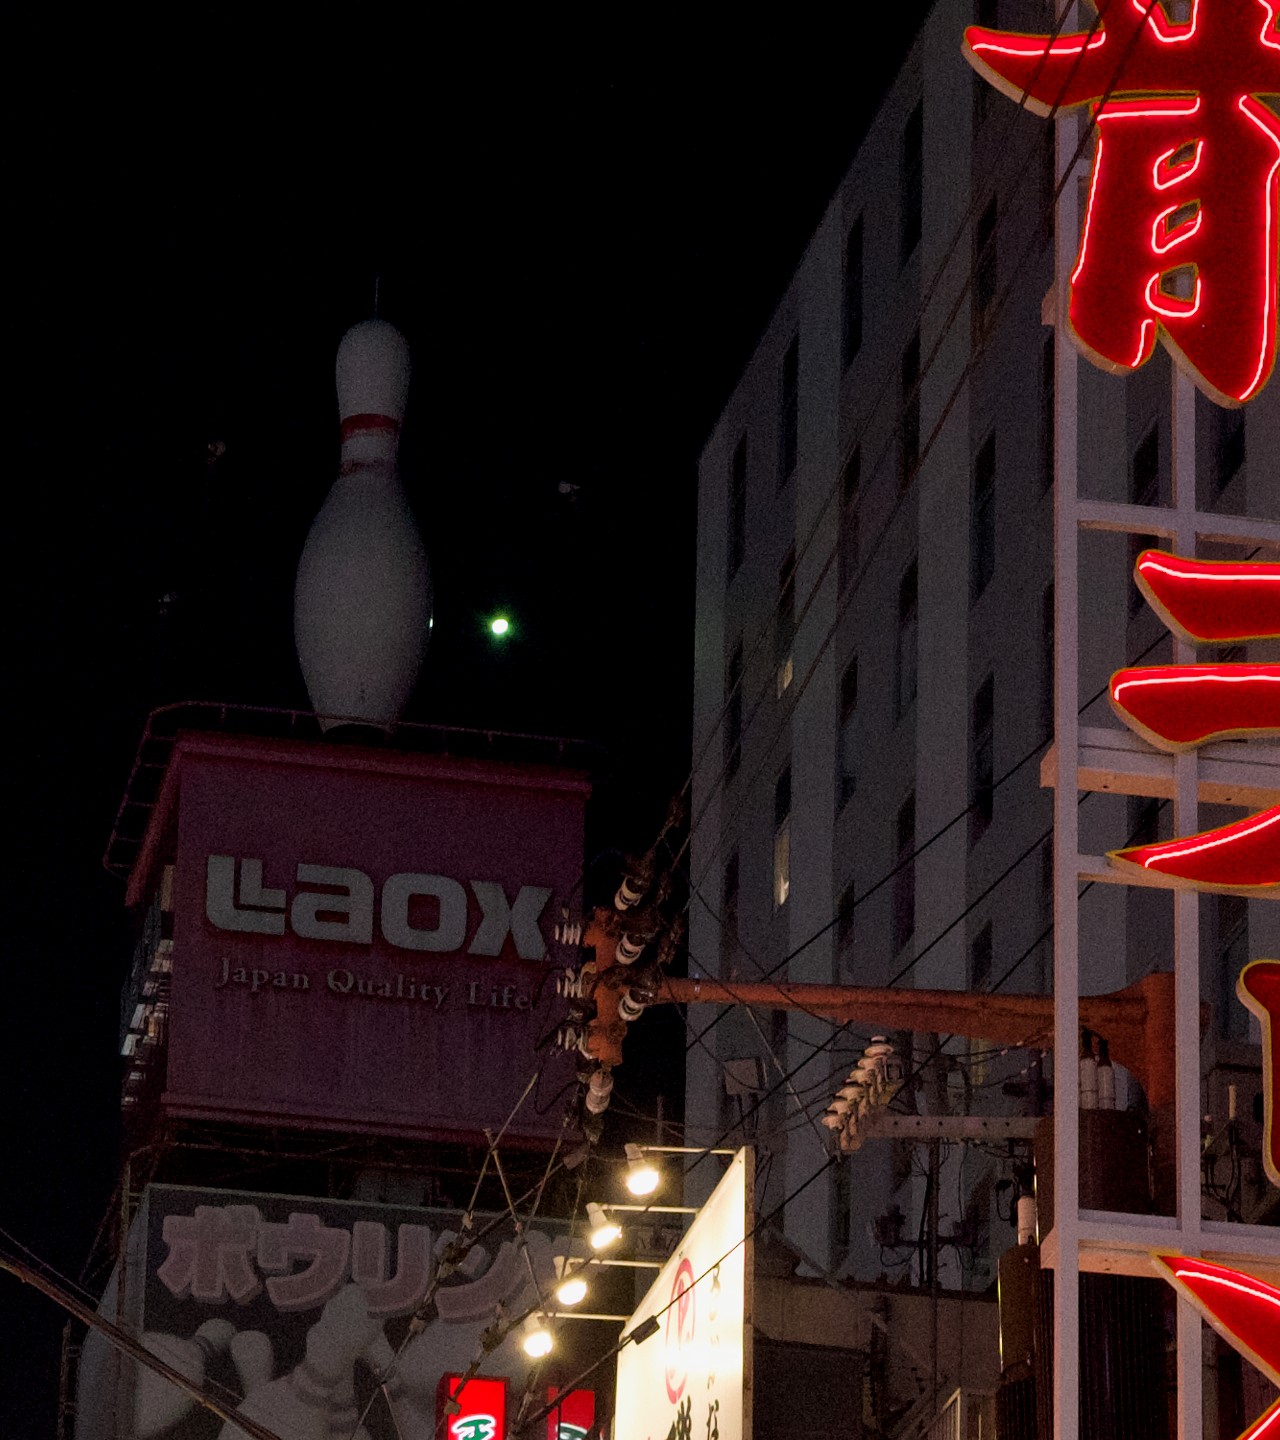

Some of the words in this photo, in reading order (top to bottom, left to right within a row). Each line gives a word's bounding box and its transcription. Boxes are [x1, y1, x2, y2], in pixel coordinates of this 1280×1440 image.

[215, 956, 310, 993] Japan
[326, 964, 451, 1010] Quality
[467, 977, 531, 1012] Life
